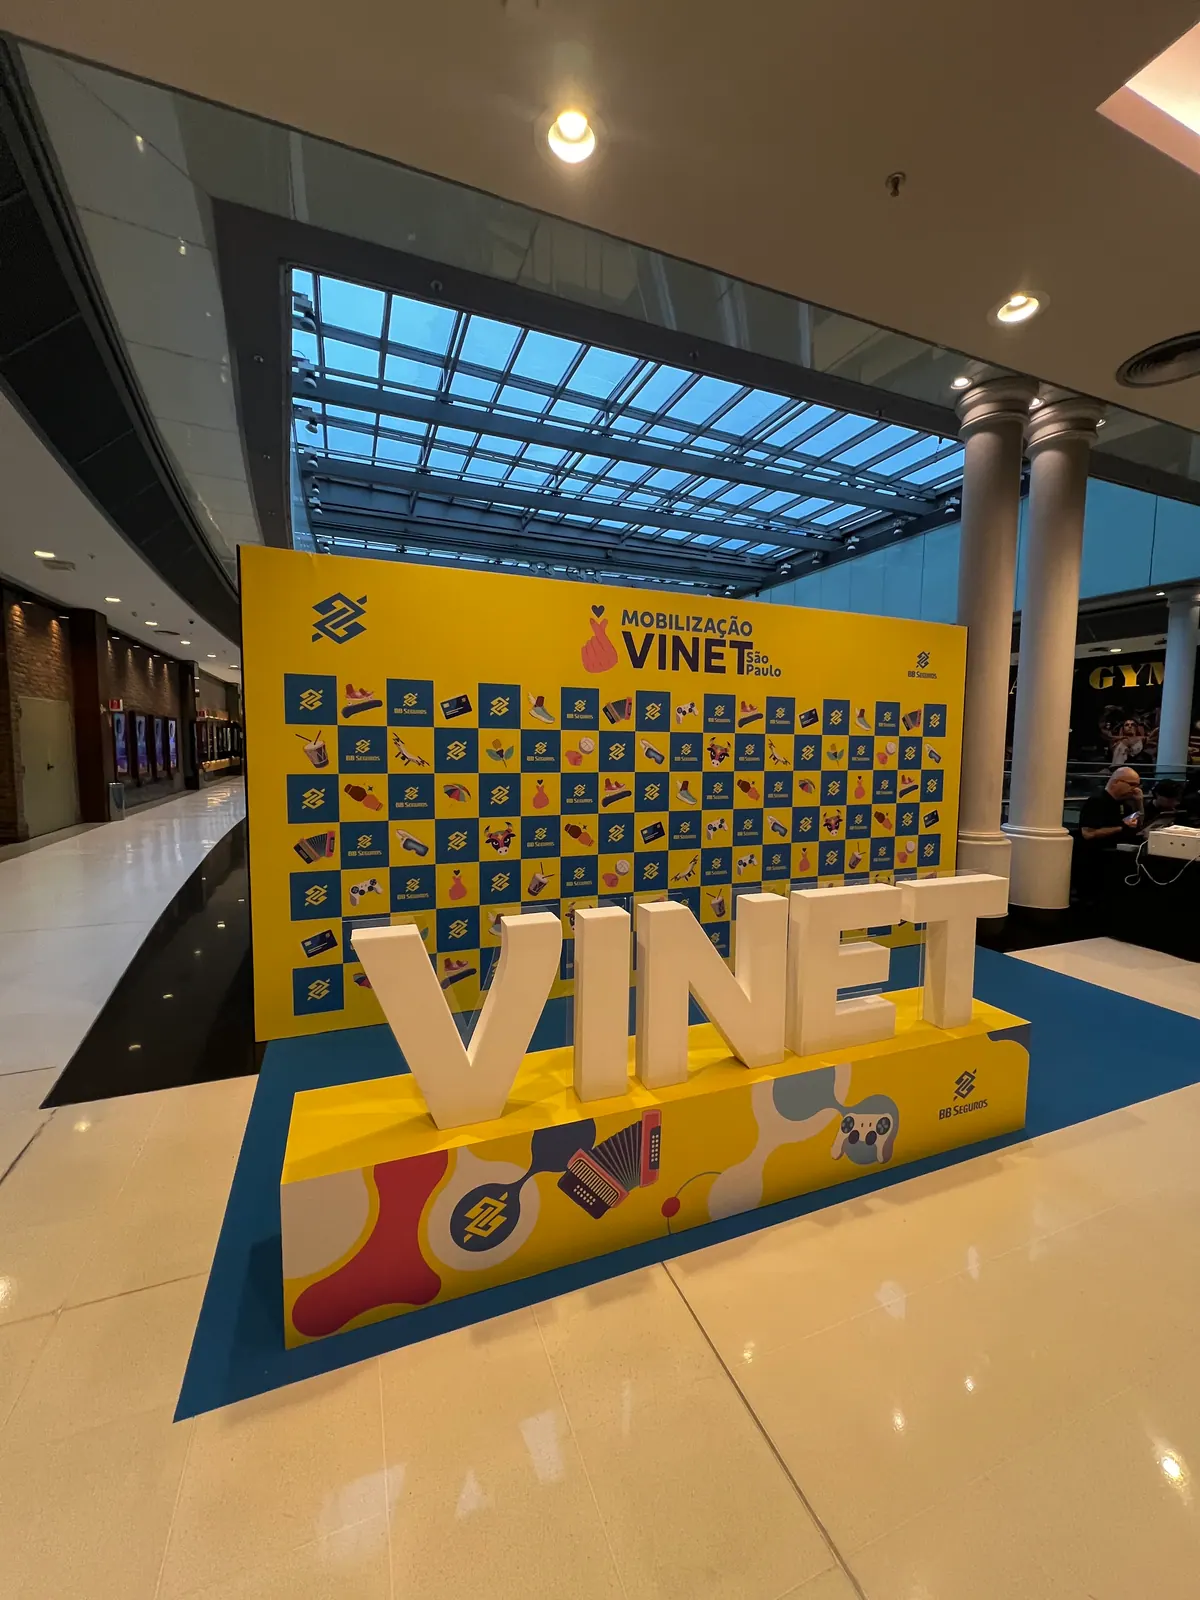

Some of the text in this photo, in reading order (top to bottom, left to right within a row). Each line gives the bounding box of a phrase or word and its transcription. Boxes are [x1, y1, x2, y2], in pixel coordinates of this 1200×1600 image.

[621, 609, 753, 639] MOBILIZAÇÃO
[621, 631, 753, 676] VINET
[746, 651, 769, 665] São
[746, 664, 782, 678] Paulo
[350, 873, 1009, 1131] VINET
[938, 1107, 952, 1120] BB
